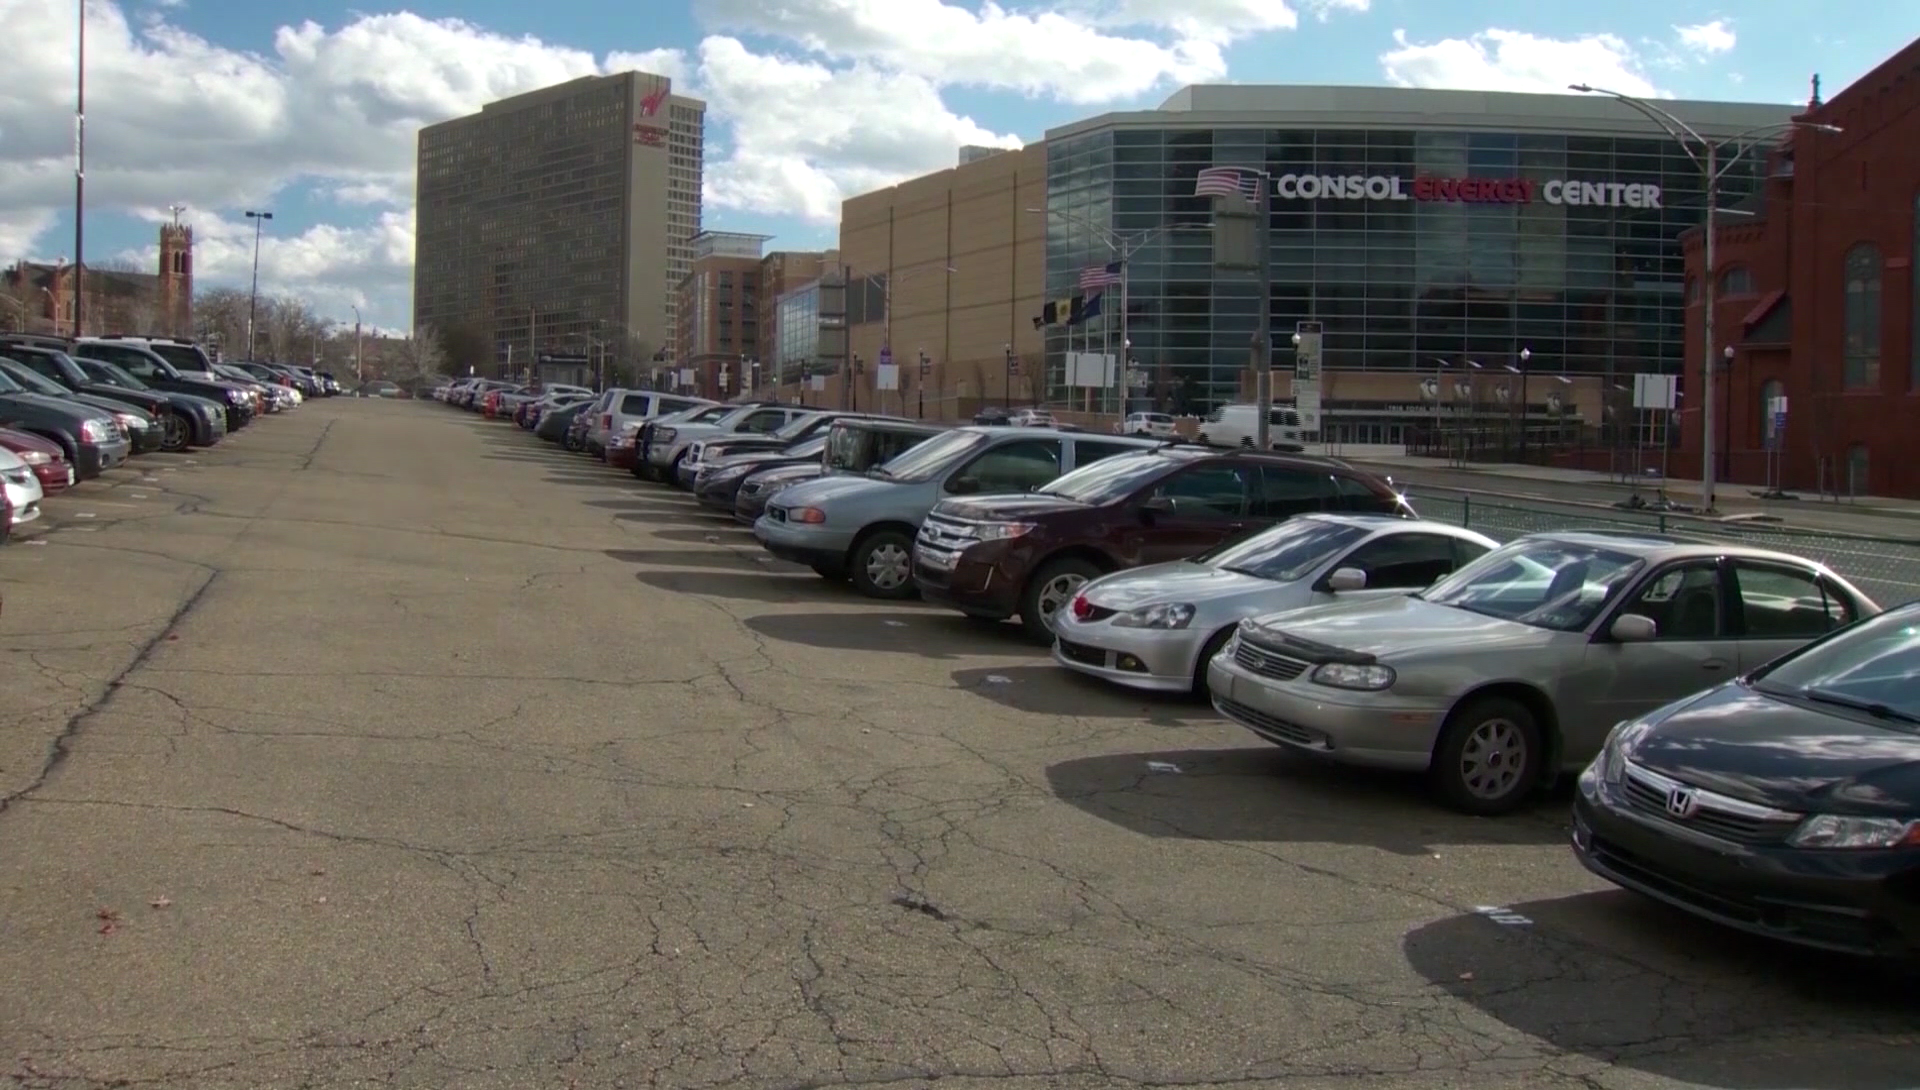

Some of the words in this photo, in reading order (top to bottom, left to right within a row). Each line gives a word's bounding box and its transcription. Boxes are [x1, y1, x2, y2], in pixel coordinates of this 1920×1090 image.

[1277, 173, 1408, 200] CONSOL
[1414, 176, 1534, 203] ENERGY
[1542, 180, 1661, 208] CENTER
